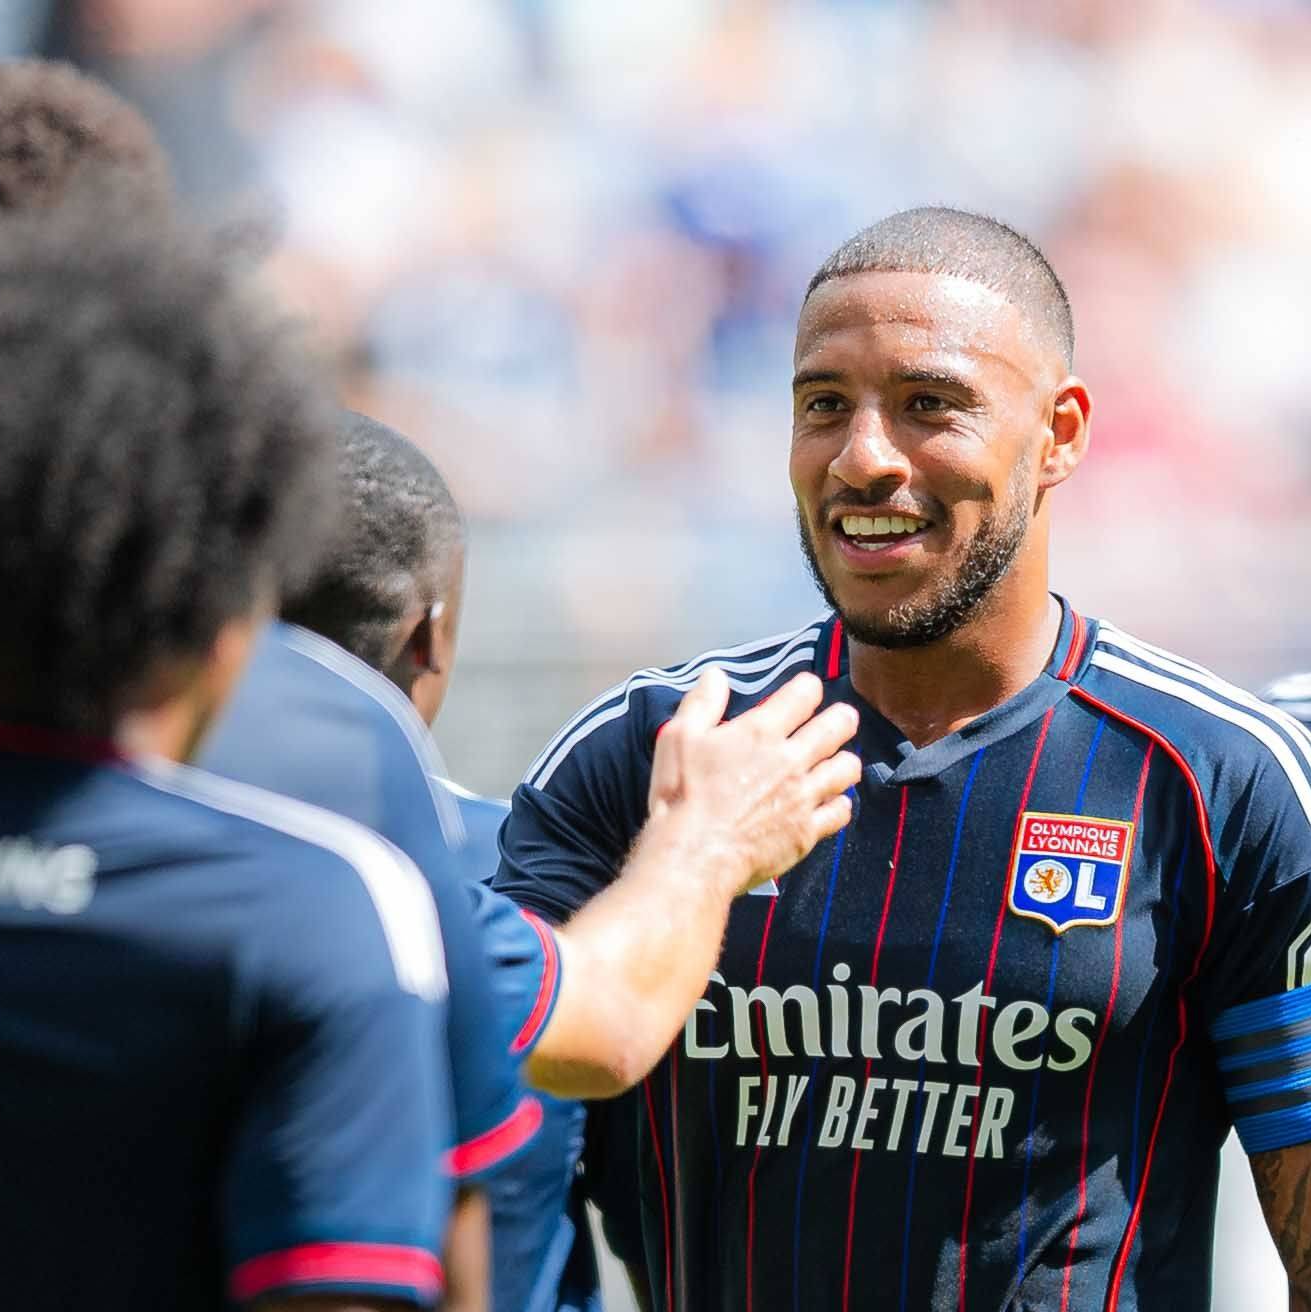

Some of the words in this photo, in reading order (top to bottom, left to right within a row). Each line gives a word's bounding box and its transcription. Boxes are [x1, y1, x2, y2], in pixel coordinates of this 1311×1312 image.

[1027, 835, 1118, 857] LYONNAIS
[1030, 823, 1121, 843] OLYMPIQUE
[685, 962, 1097, 1072] Emirates
[735, 1075, 810, 1148] FLY
[818, 1076, 1016, 1161] BETTER
